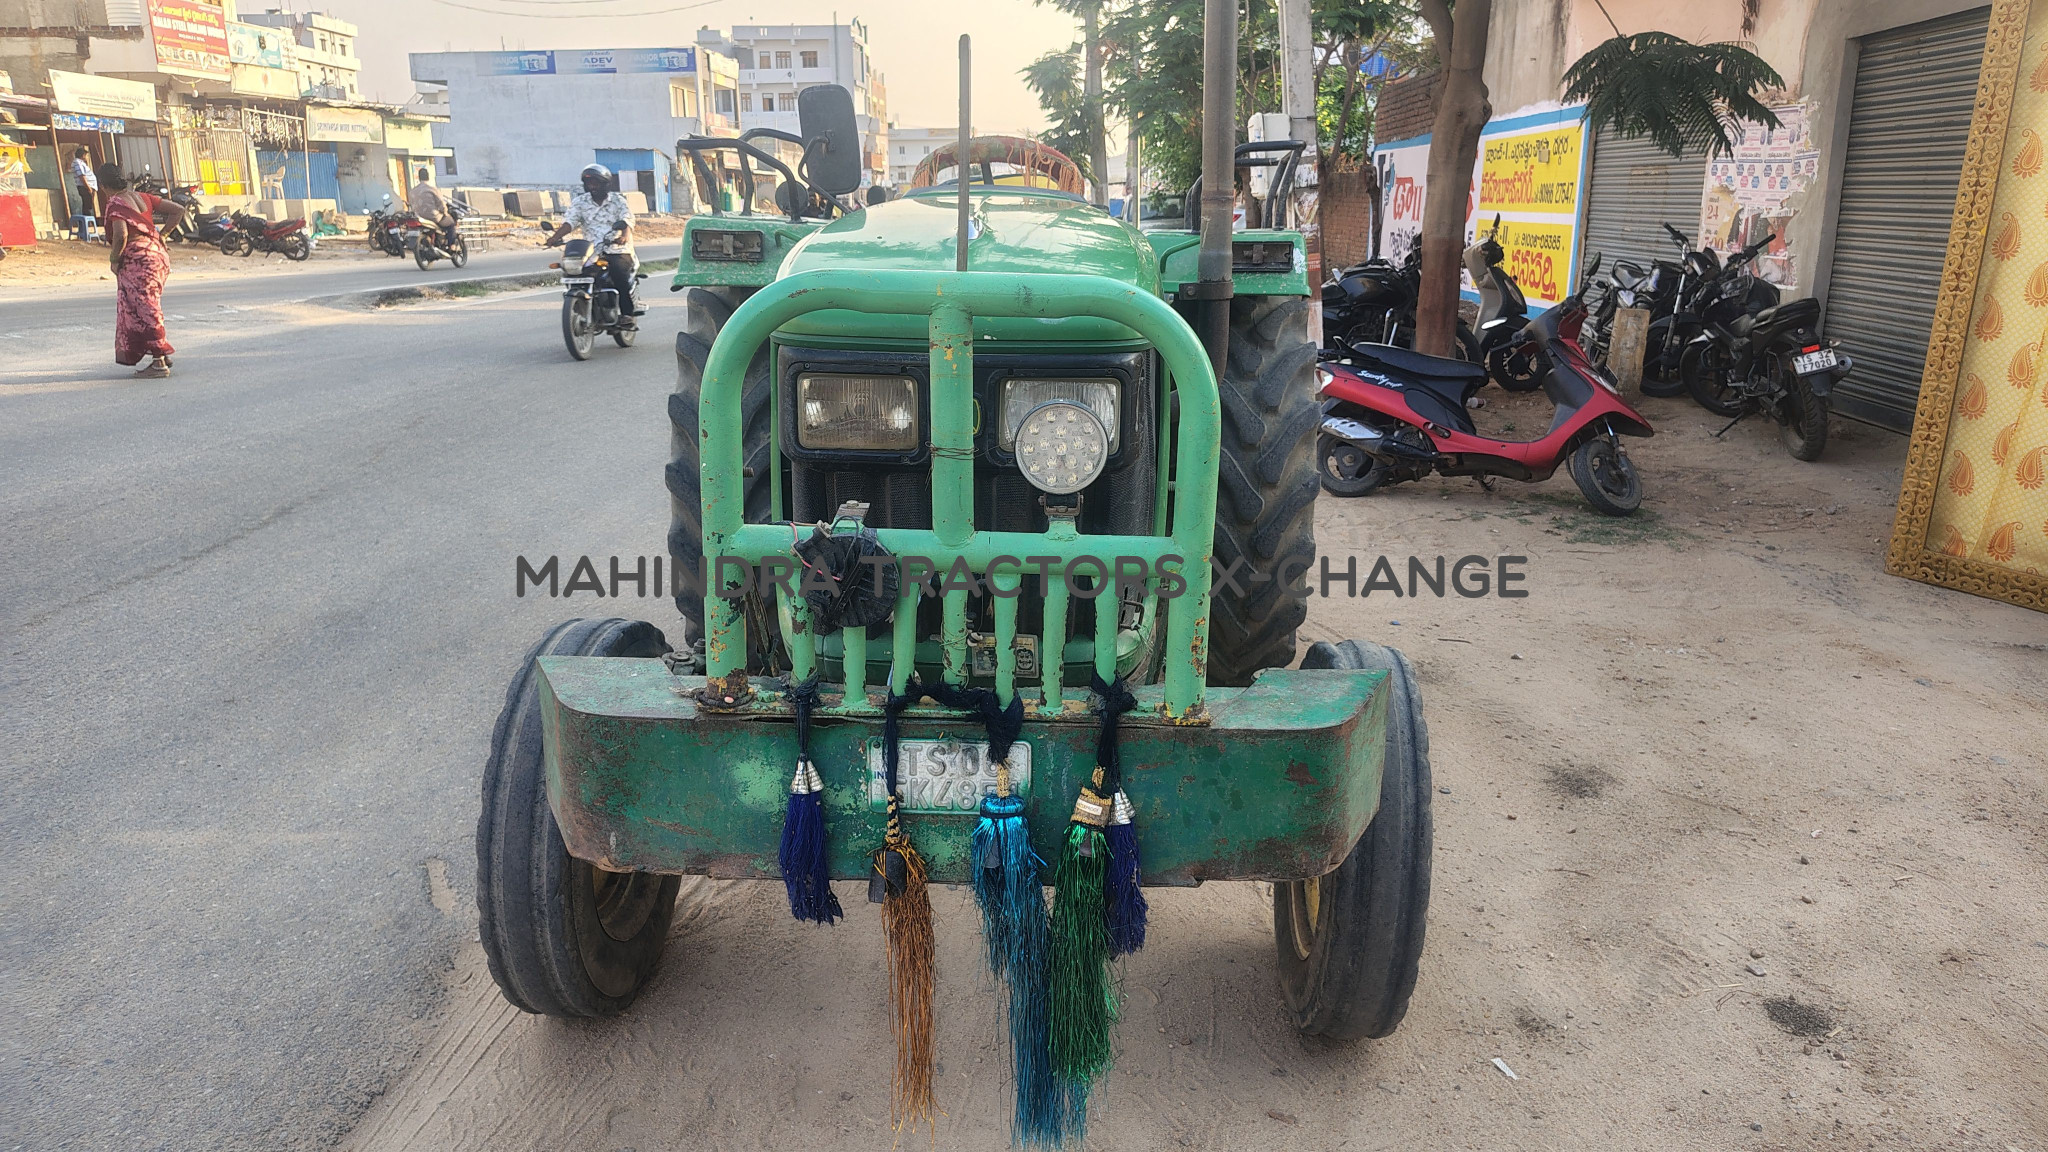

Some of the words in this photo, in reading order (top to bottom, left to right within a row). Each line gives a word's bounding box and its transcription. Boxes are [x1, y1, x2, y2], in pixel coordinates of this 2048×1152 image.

[1801, 355, 1813, 364] TS
[1818, 350, 1831, 360] 32
[1803, 358, 1833, 372] F7020
[1357, 370, 1389, 385] Scooty
[903, 744, 946, 777] TS
